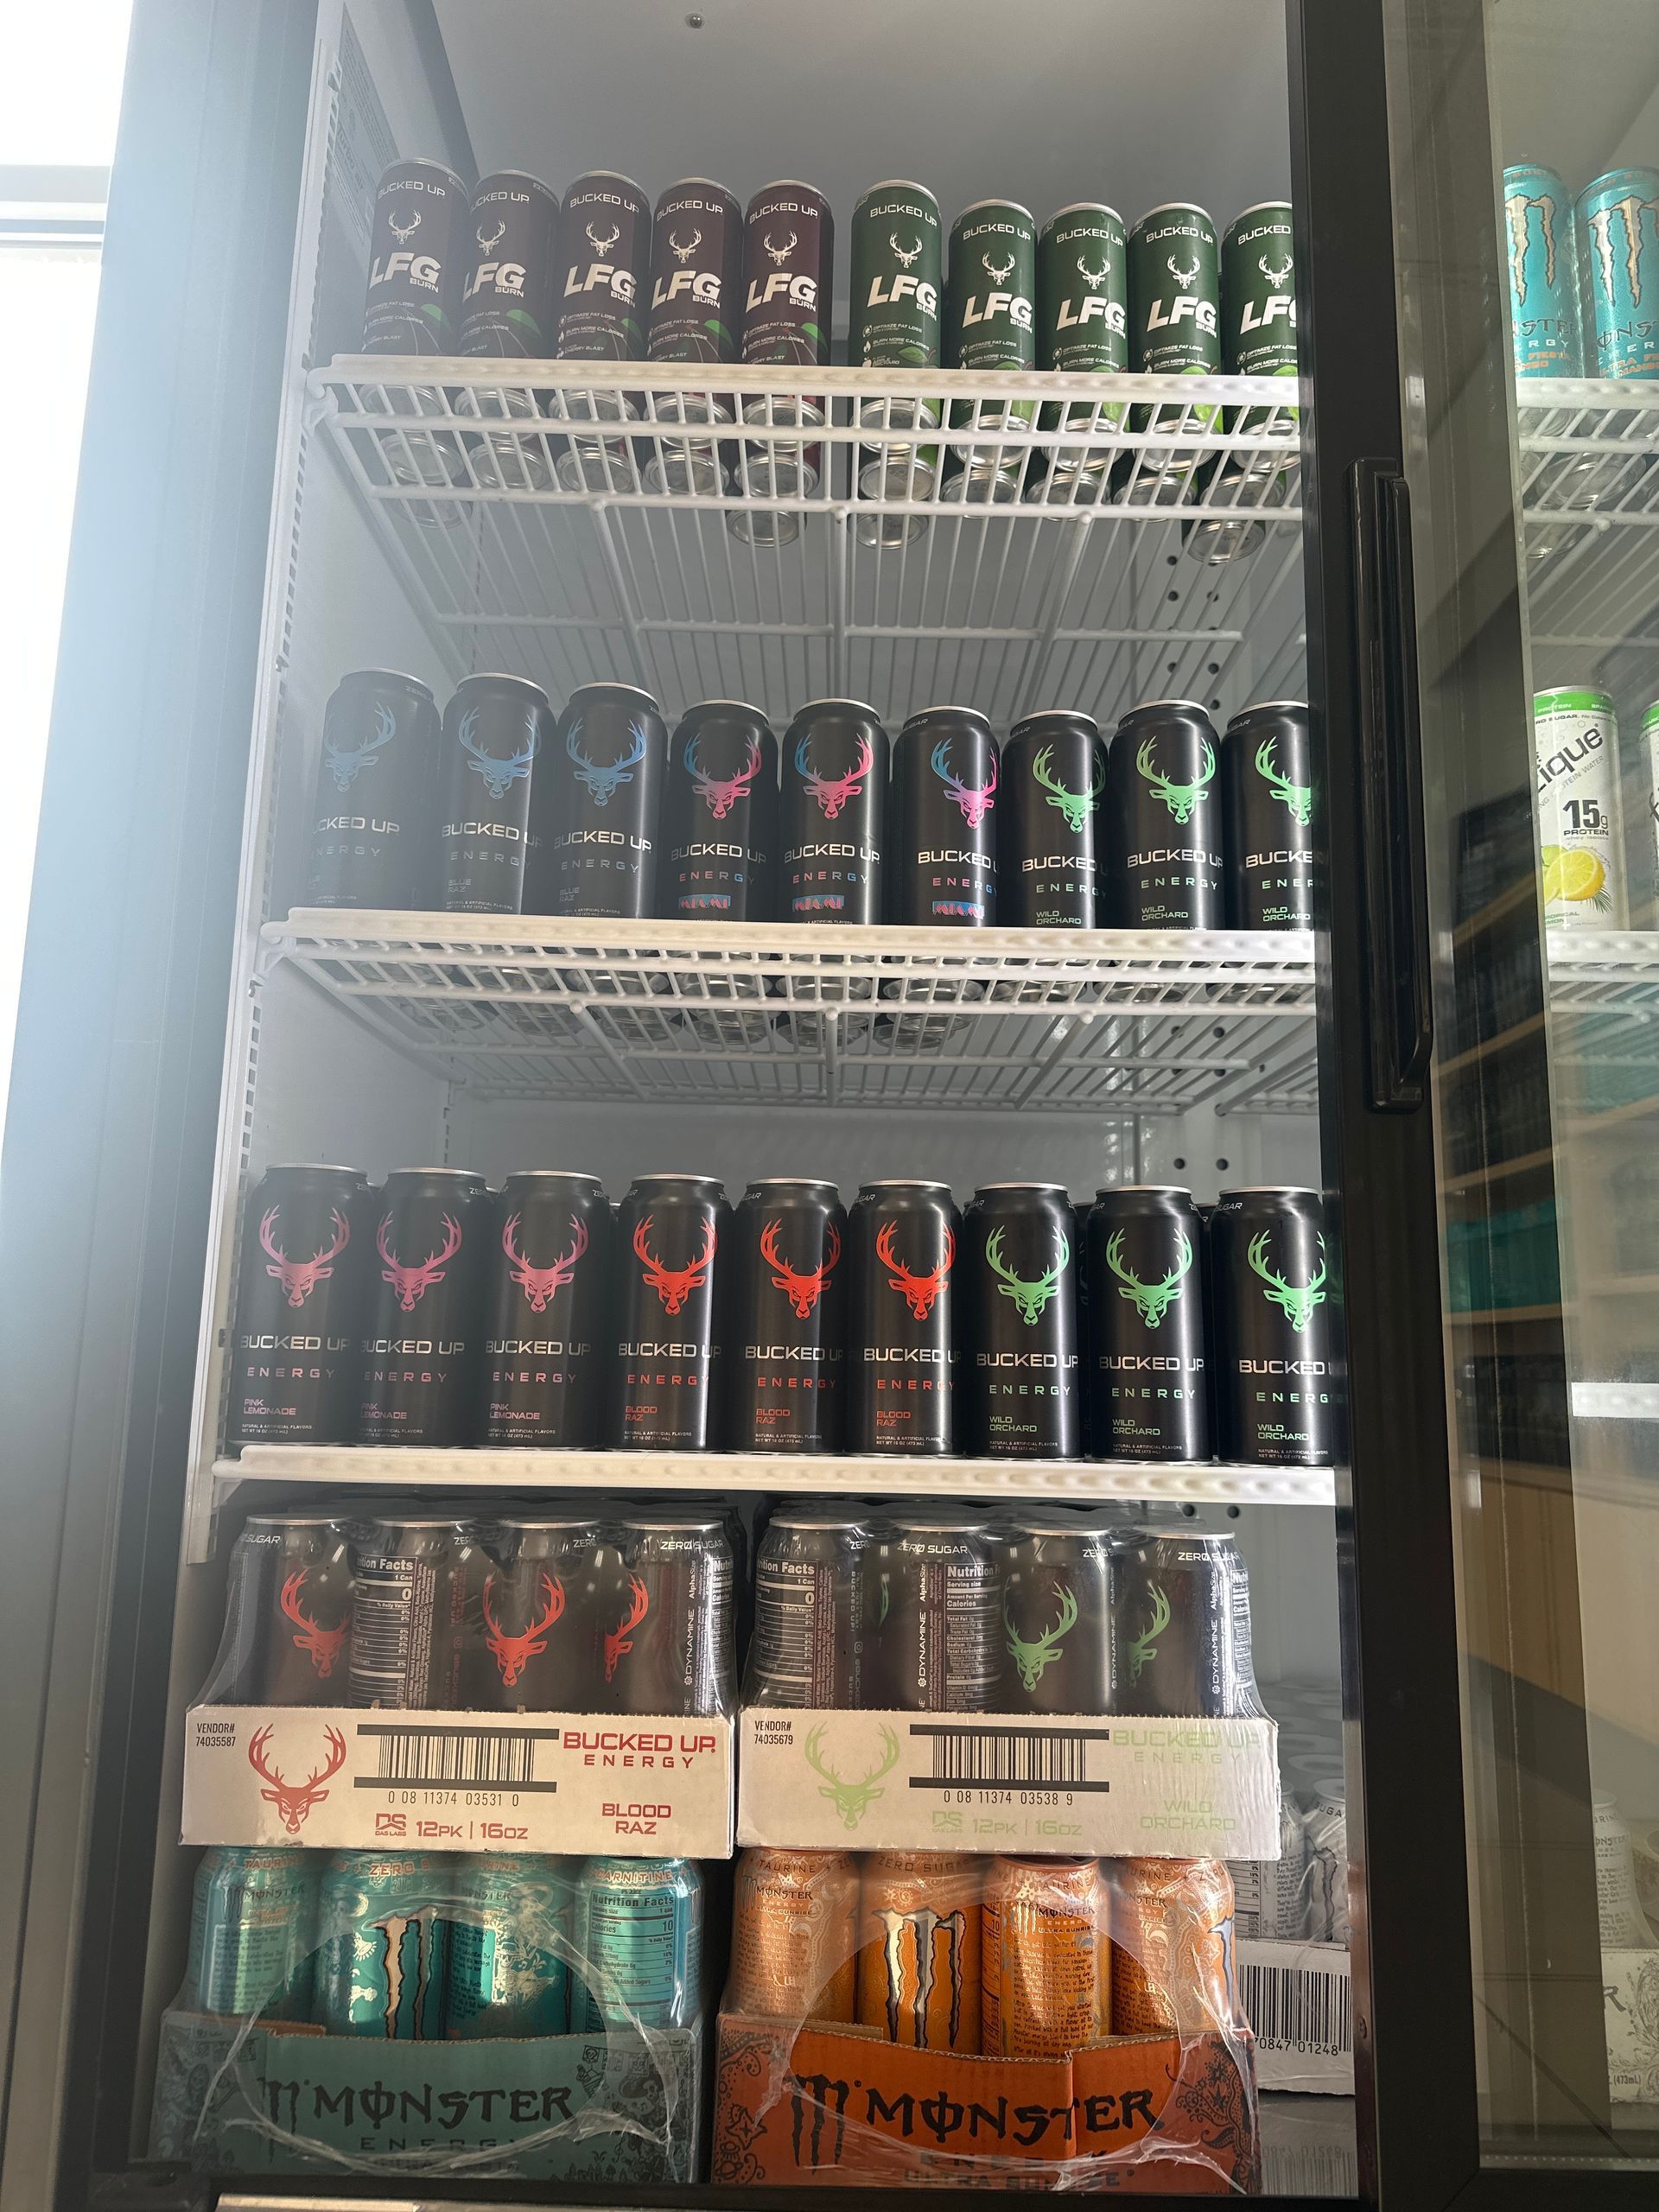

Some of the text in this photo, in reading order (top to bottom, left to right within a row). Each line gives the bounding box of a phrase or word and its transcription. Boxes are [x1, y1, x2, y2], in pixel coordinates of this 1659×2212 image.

[511, 194, 530, 203] UP
[569, 194, 620, 207] BUCKED
[657, 200, 723, 221] BUCKED UP
[749, 203, 818, 225] BUCKED UP
[870, 205, 937, 227] BUCKED UP
[963, 224, 1031, 241] BUCKED UP
[1146, 226, 1213, 245] BUCKED UP
[1238, 225, 1290, 245] BUCKED
[1111, 233, 1123, 247] UP
[368, 252, 442, 290] LFG
[410, 277, 439, 293] BURN
[462, 262, 526, 302] LFG
[563, 264, 637, 298] LFG
[495, 286, 524, 297] BURN
[652, 270, 721, 311] LFG
[746, 273, 817, 314] LFG
[868, 274, 937, 313] LFG
[610, 291, 635, 308] BURN
[790, 297, 816, 312] BURN
[917, 302, 937, 321] BURN
[963, 292, 1033, 328] LFG
[1056, 296, 1125, 331] LFG
[1147, 296, 1217, 332] LFG
[1010, 317, 1032, 334] BURN
[1581, 755, 1604, 773] WATER
[554, 831, 652, 853] BUCKED UP
[671, 843, 766, 864] BUCKED UP
[785, 844, 880, 864] BUCKED UP
[1128, 849, 1223, 868] BUCKED UP
[562, 859, 639, 873] ENERGY
[792, 871, 868, 884] ENERGY
[680, 899, 729, 909] MIAMI
[795, 897, 842, 911] MIAMI
[1141, 912, 1188, 920] ORCHARD
[1263, 912, 1310, 922] ORCHARD
[439, 1342, 464, 1355] UP
[486, 1341, 563, 1355] BUCKED
[746, 1346, 824, 1361] BUCKED
[977, 1353, 1078, 1369] BUCKED UP
[1185, 1358, 1204, 1371] UP
[1239, 1359, 1325, 1375] BUCKED
[247, 1367, 334, 1378] ENERGY
[365, 1372, 447, 1382] ENERGY
[493, 1372, 576, 1382] ENERGY
[627, 1375, 709, 1385] ENERGY
[758, 1377, 836, 1389] ENERGY
[878, 1379, 955, 1390] ENERGY
[989, 1385, 1070, 1395] ENERGY
[1112, 1388, 1195, 1399] ENERGY
[244, 1407, 296, 1415] LEMONADE
[756, 1408, 790, 1417] BLOOD
[877, 1410, 911, 1419] BLOOD
[245, 1535, 280, 1545] SUGAR
[927, 1545, 968, 1554] SUGAR
[380, 1558, 413, 1571] Facts
[781, 1561, 815, 1575] Facts
[947, 1565, 993, 1579] Nutrition
[947, 1599, 976, 1608] Calories
[685, 1609, 695, 1675] DYNAMINE
[197, 1723, 235, 1733] VENDOR#
[754, 1720, 791, 1731] VENDOR#
[196, 1737, 236, 1746] 74035587
[563, 1732, 715, 1752] BUCKED UP
[754, 1734, 793, 1745] 74035679
[1113, 1730, 1220, 1747] BUCKED
[584, 1754, 693, 1769] ENERGY
[1135, 1751, 1240, 1764] ENERGY
[388, 1791, 518, 1807] 0 08 11374 03531 0
[944, 1790, 1072, 1805] 0 08 11374 03538 9
[602, 1803, 671, 1818] BLOOD
[1164, 1801, 1213, 1813] WILD
[416, 1821, 462, 1838] 12PK
[615, 1821, 657, 1835] RAZ
[1140, 1816, 1236, 1831] ORCHARD
[370, 1862, 415, 1877] ZERO
[760, 1859, 815, 1873] TAURINE
[879, 1857, 912, 1872] ZERO
[597, 1871, 672, 1883] CARNITINE
[593, 1894, 674, 1907] Nutrition Facts
[663, 1920, 673, 1932] 10
[1298, 2040, 1339, 2056] 01248
[1612, 2073, 1641, 2086] (473mL)
